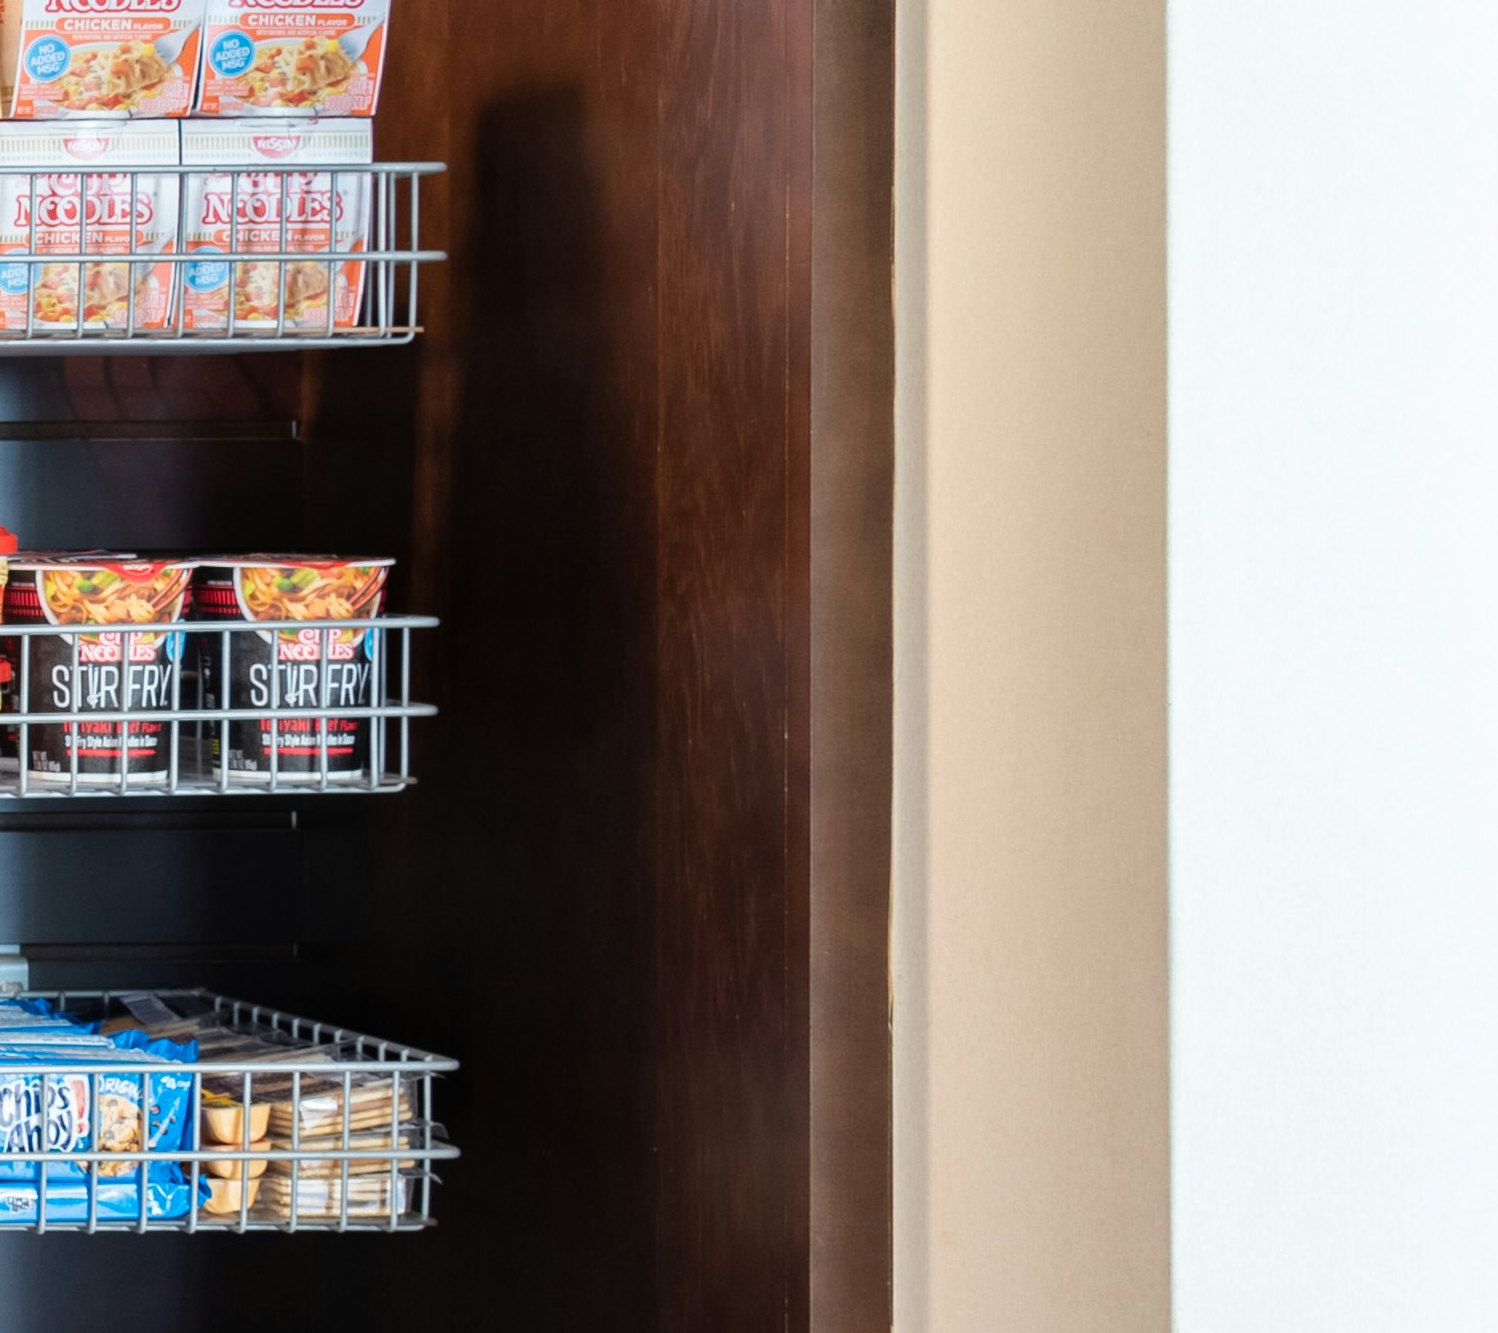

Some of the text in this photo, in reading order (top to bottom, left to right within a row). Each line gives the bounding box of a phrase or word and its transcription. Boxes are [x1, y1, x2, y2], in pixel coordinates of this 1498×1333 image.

[64, 18, 131, 32] CHICKEN
[248, 13, 316, 27] CHICKEN
[38, 43, 55, 55] NO
[30, 50, 66, 67] ADDED
[37, 60, 59, 74] MSG
